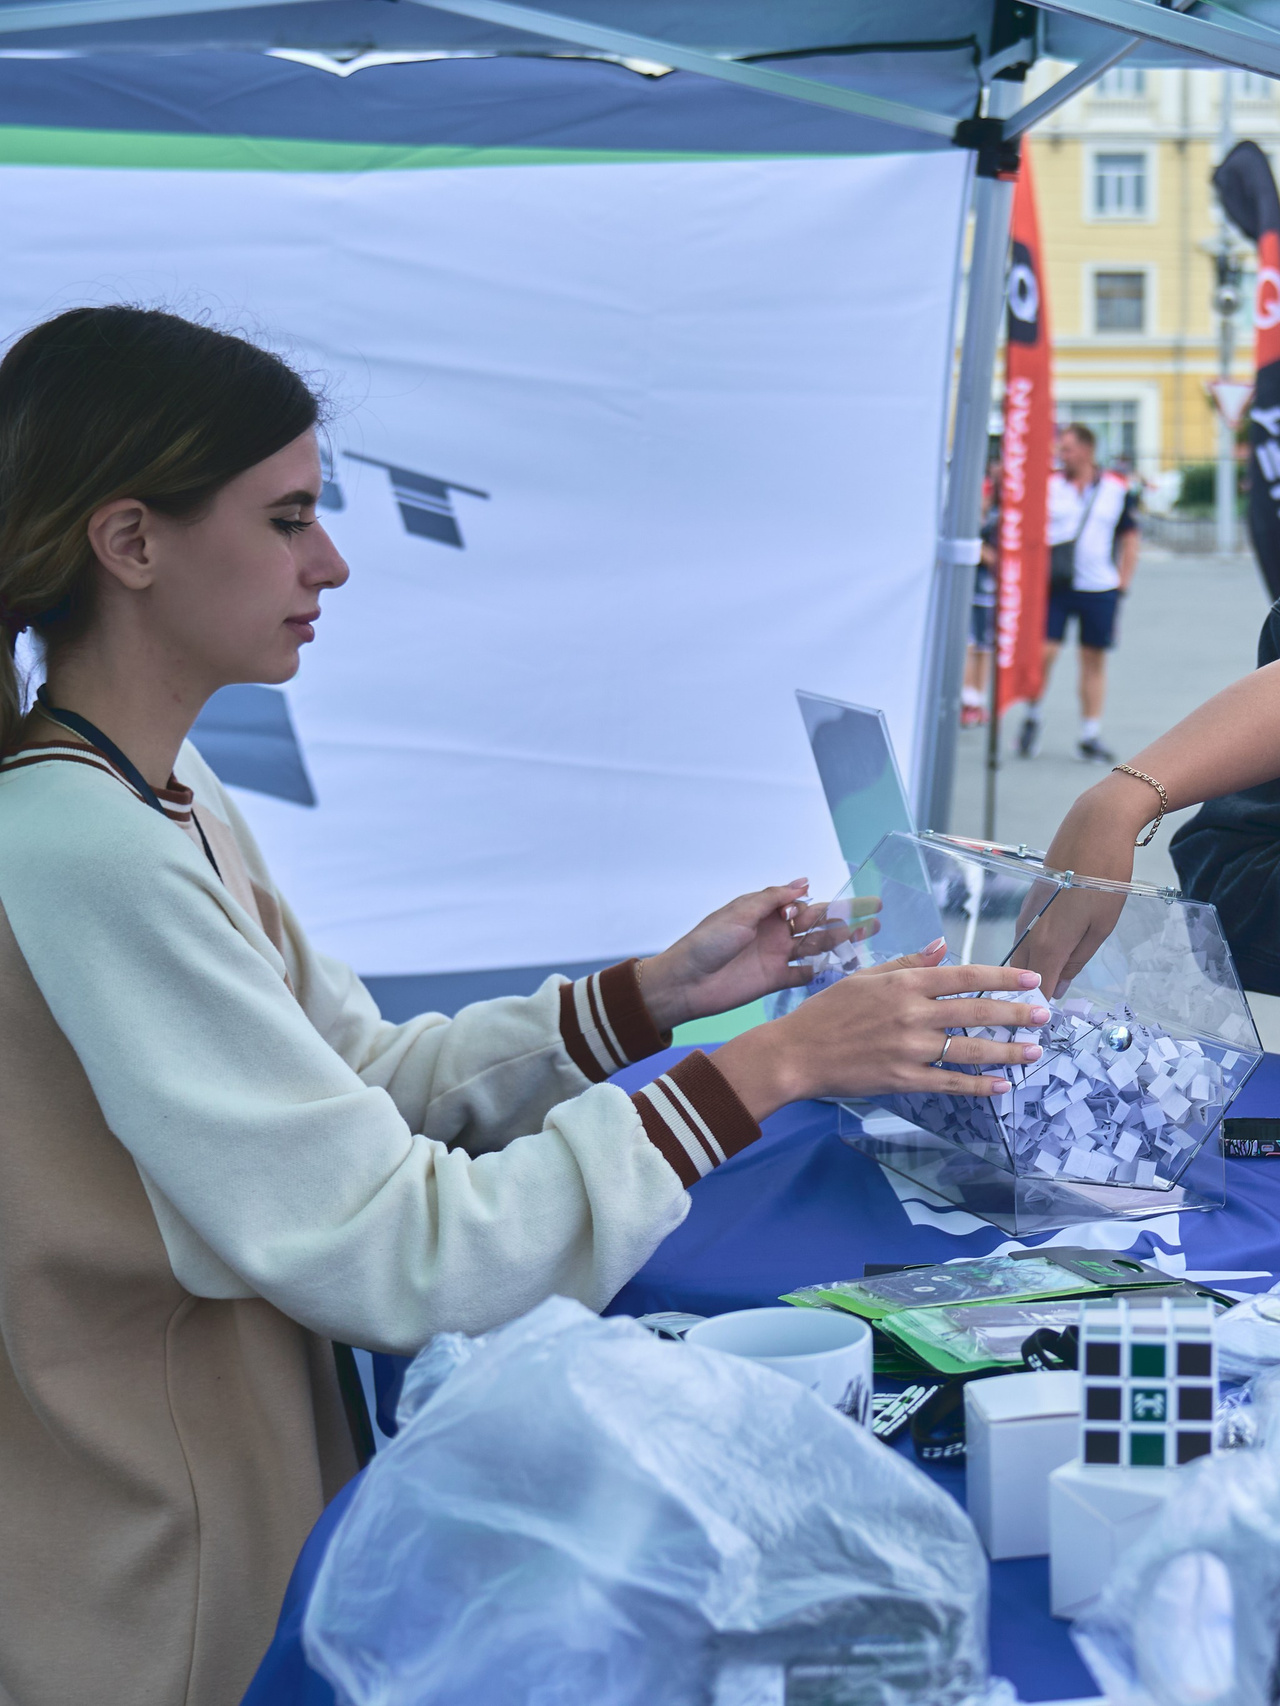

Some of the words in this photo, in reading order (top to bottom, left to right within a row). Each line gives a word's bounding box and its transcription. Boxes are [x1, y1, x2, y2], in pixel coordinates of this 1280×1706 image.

[1003, 377, 1034, 502] JAPAN
[1001, 507, 1023, 551] IN
[998, 559, 1022, 669] MADE
